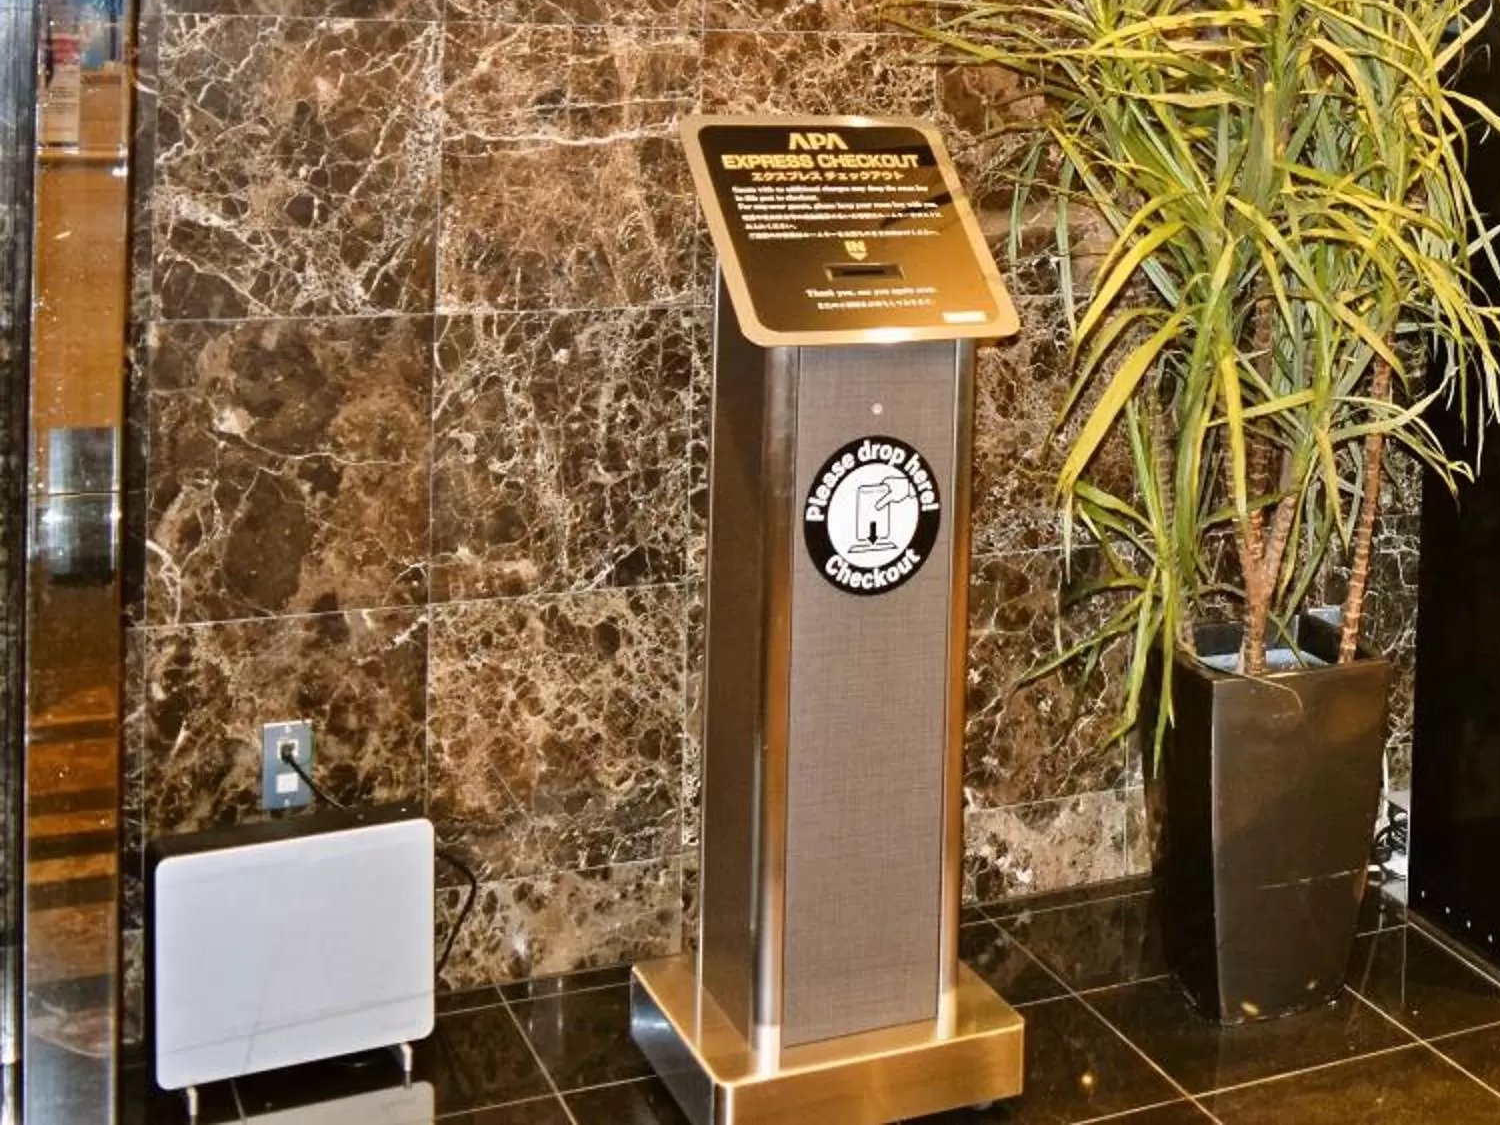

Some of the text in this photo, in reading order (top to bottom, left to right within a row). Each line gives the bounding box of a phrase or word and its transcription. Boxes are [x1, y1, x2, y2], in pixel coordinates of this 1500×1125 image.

[788, 132, 849, 150] APA
[721, 154, 919, 170] EXPRESS CHECKOUT
[805, 439, 940, 522] Please drop here!
[825, 547, 921, 590] Checkout
